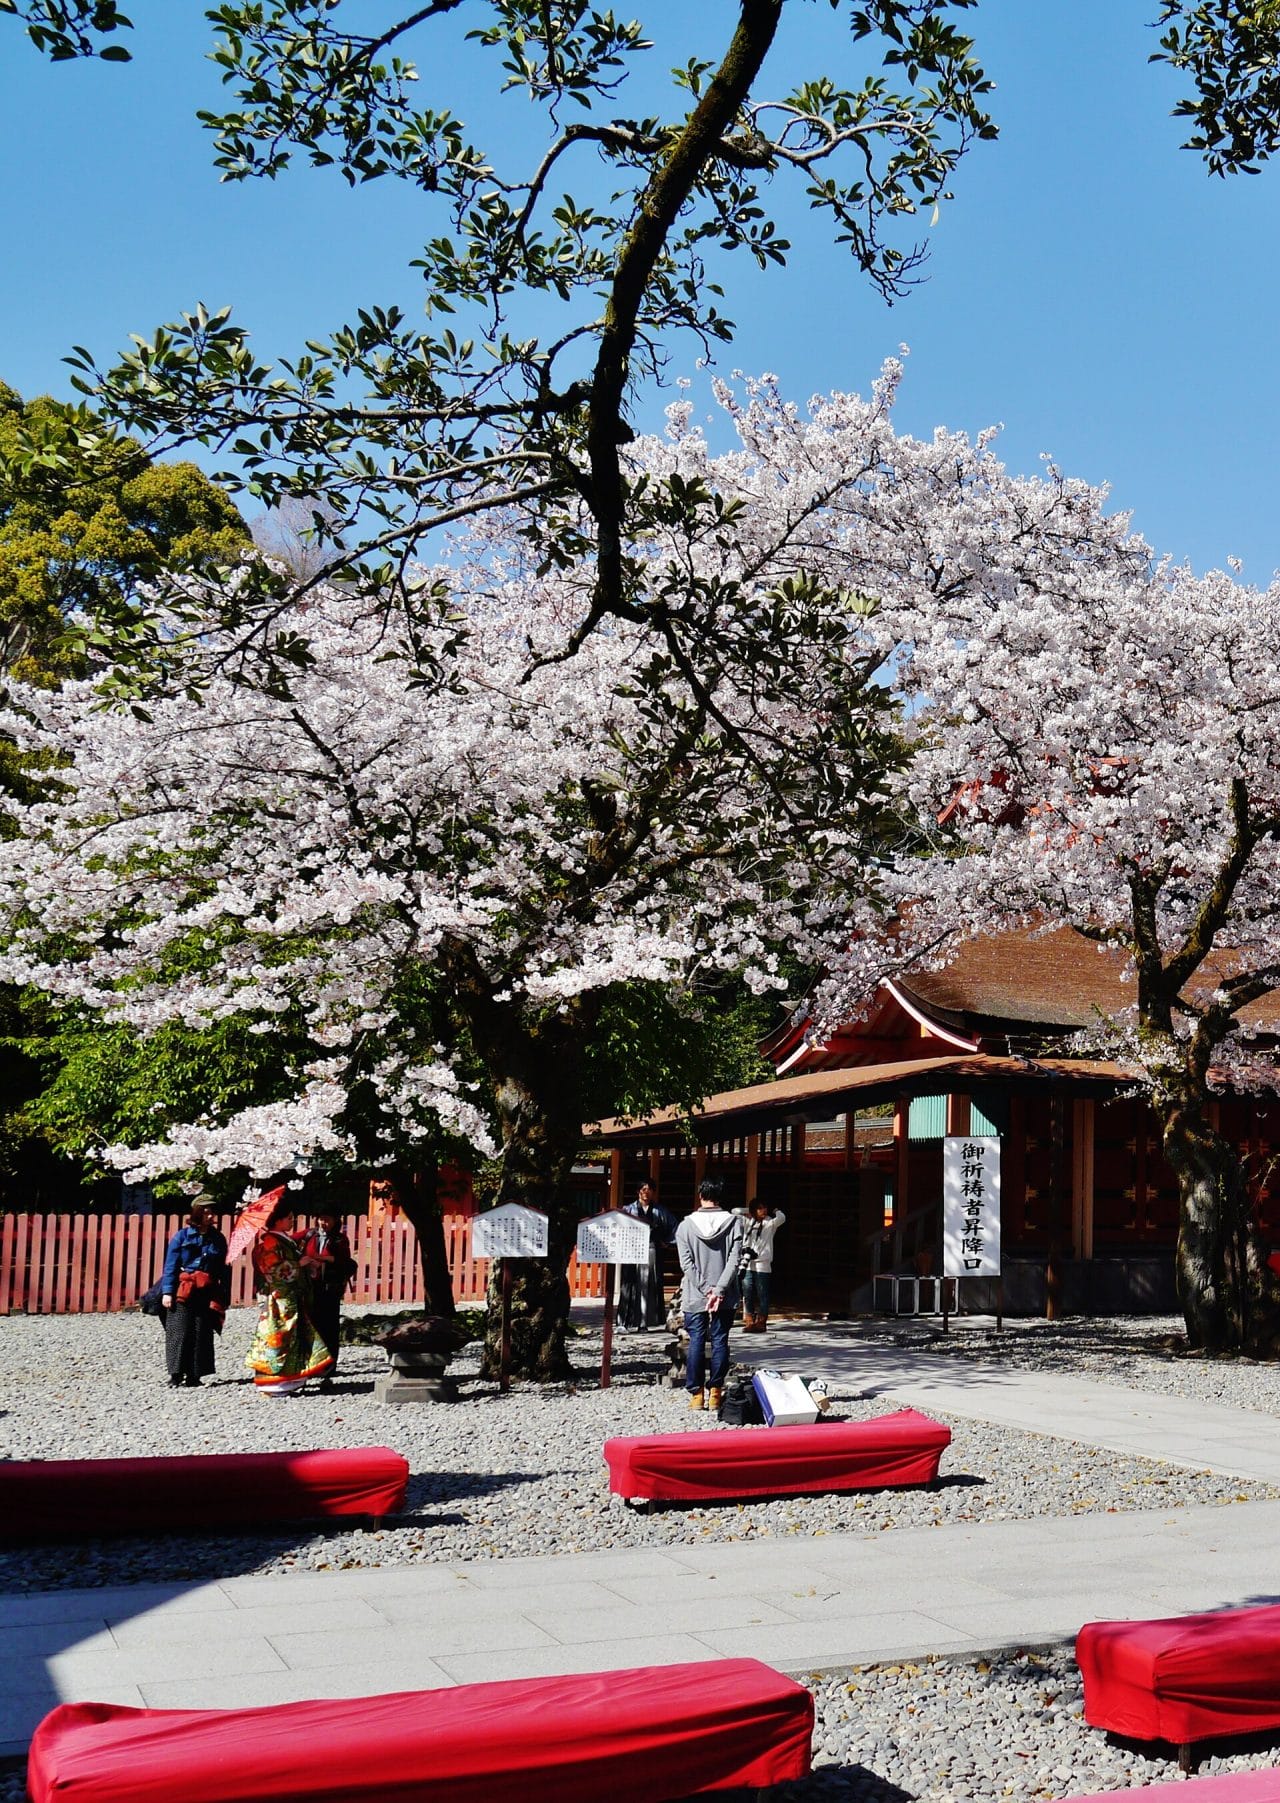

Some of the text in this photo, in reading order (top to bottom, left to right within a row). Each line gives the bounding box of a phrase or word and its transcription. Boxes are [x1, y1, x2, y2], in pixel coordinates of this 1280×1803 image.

[960, 1143, 985, 1270] 御祈祷者昇降口
